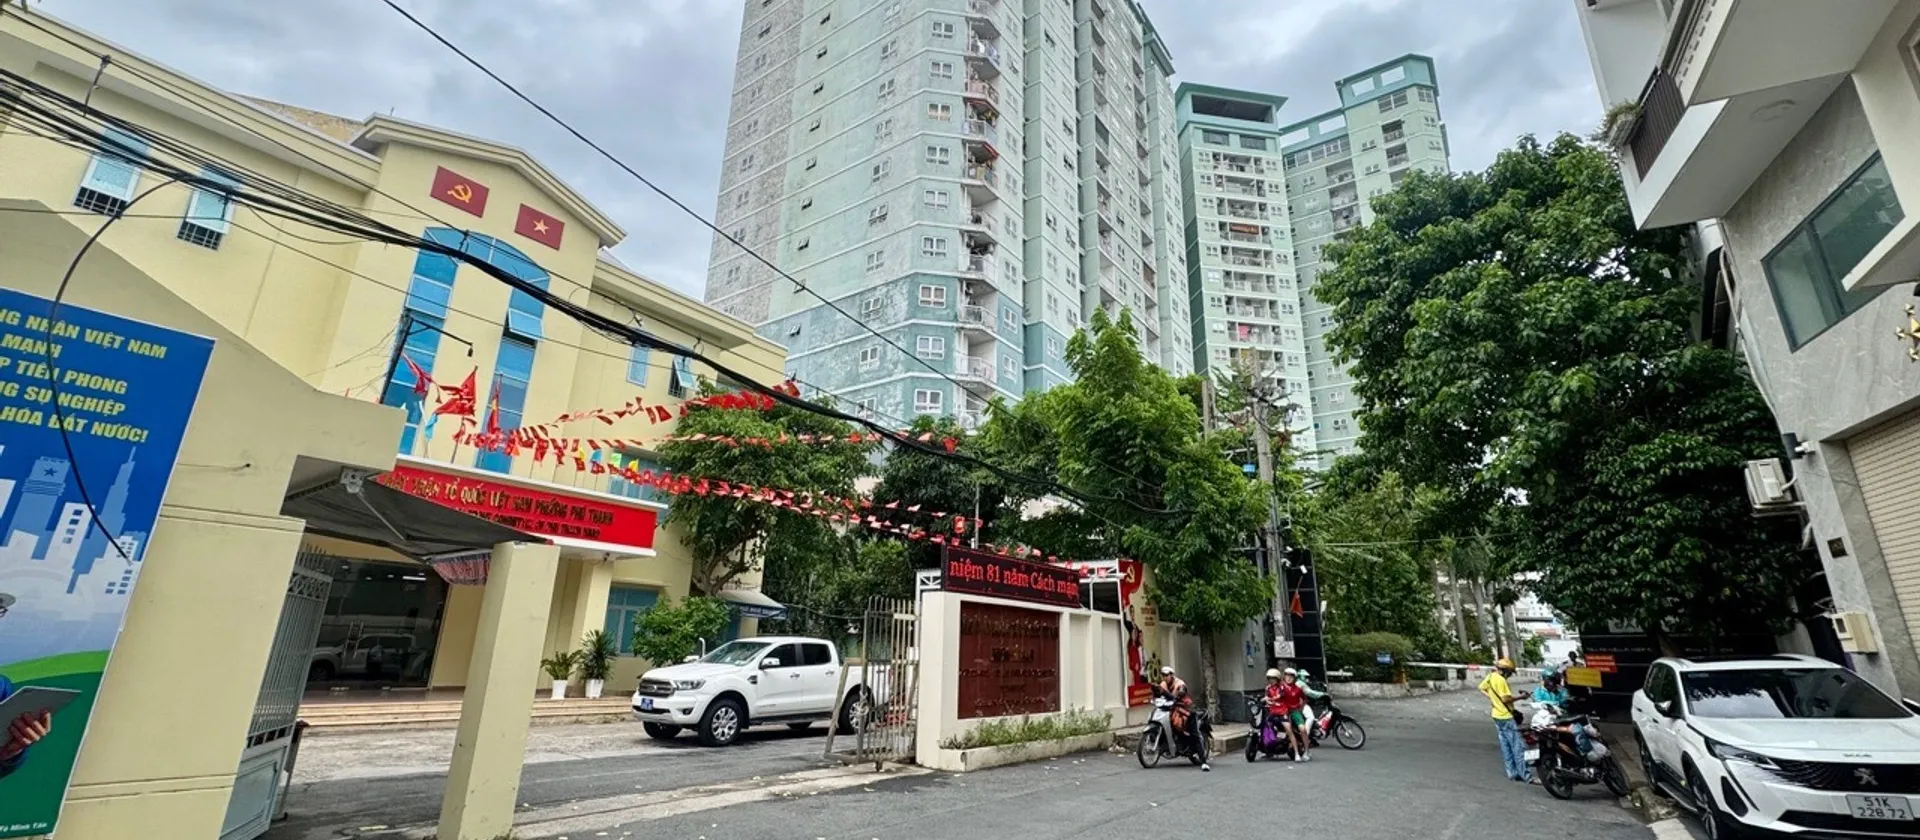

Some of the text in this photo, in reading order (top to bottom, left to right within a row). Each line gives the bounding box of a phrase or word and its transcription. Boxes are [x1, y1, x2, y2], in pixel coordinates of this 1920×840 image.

[1, 333, 63, 358] MẠNH
[25, 314, 80, 339] NHÂN
[84, 328, 125, 349] VIỆT
[127, 339, 167, 359] NAM
[63, 369, 128, 394] PHONG
[57, 391, 126, 416] NGHIỆP
[0, 406, 43, 426] HÓA
[90, 420, 149, 443] NƯỚC!
[949, 558, 984, 582] niệm
[986, 563, 1001, 583] 81
[1003, 568, 1029, 588] năm
[1030, 571, 1055, 593] Cách
[1864, 796, 1892, 808] 51K
